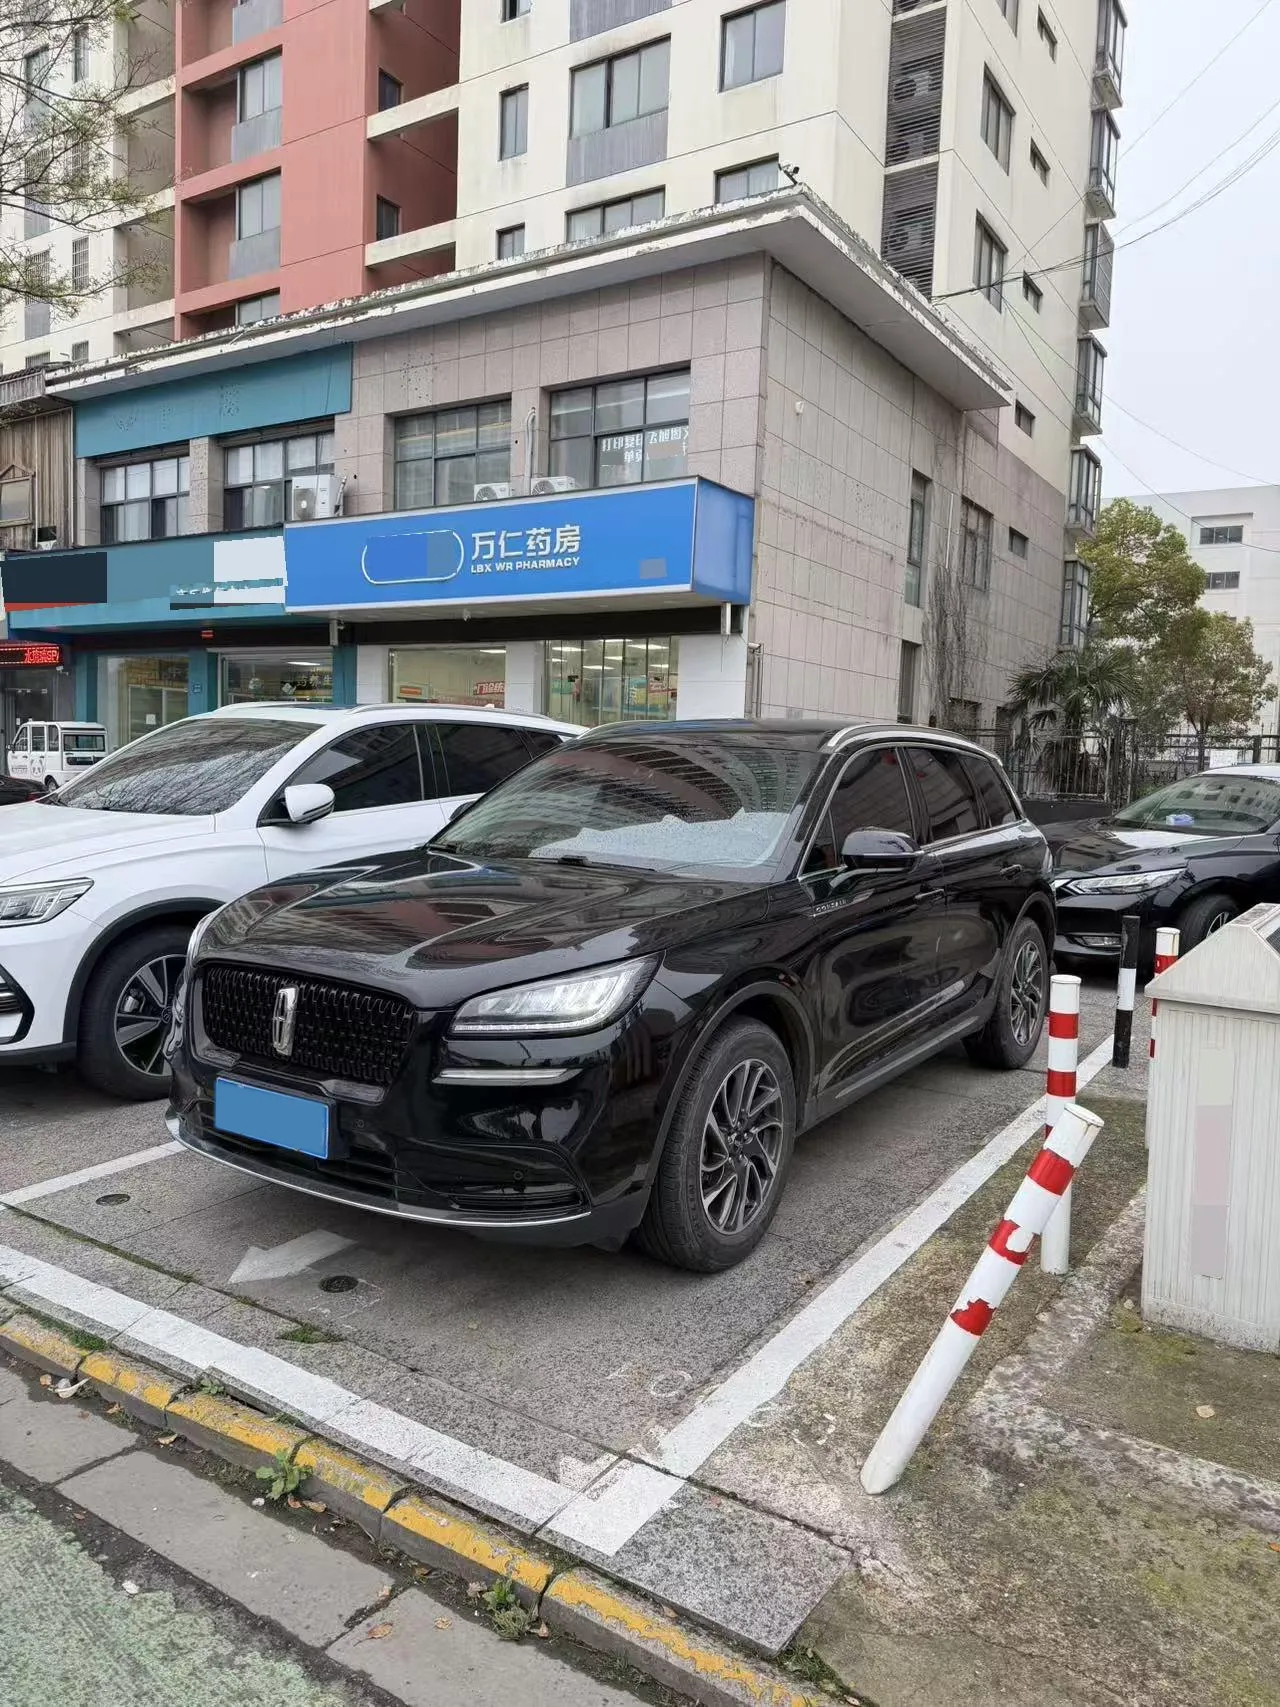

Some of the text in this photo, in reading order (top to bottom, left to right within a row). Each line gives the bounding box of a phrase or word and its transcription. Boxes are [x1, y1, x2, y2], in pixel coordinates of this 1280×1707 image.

[471, 524, 582, 560] 万仁药房
[470, 556, 581, 573] LBX WR PHARMACY
